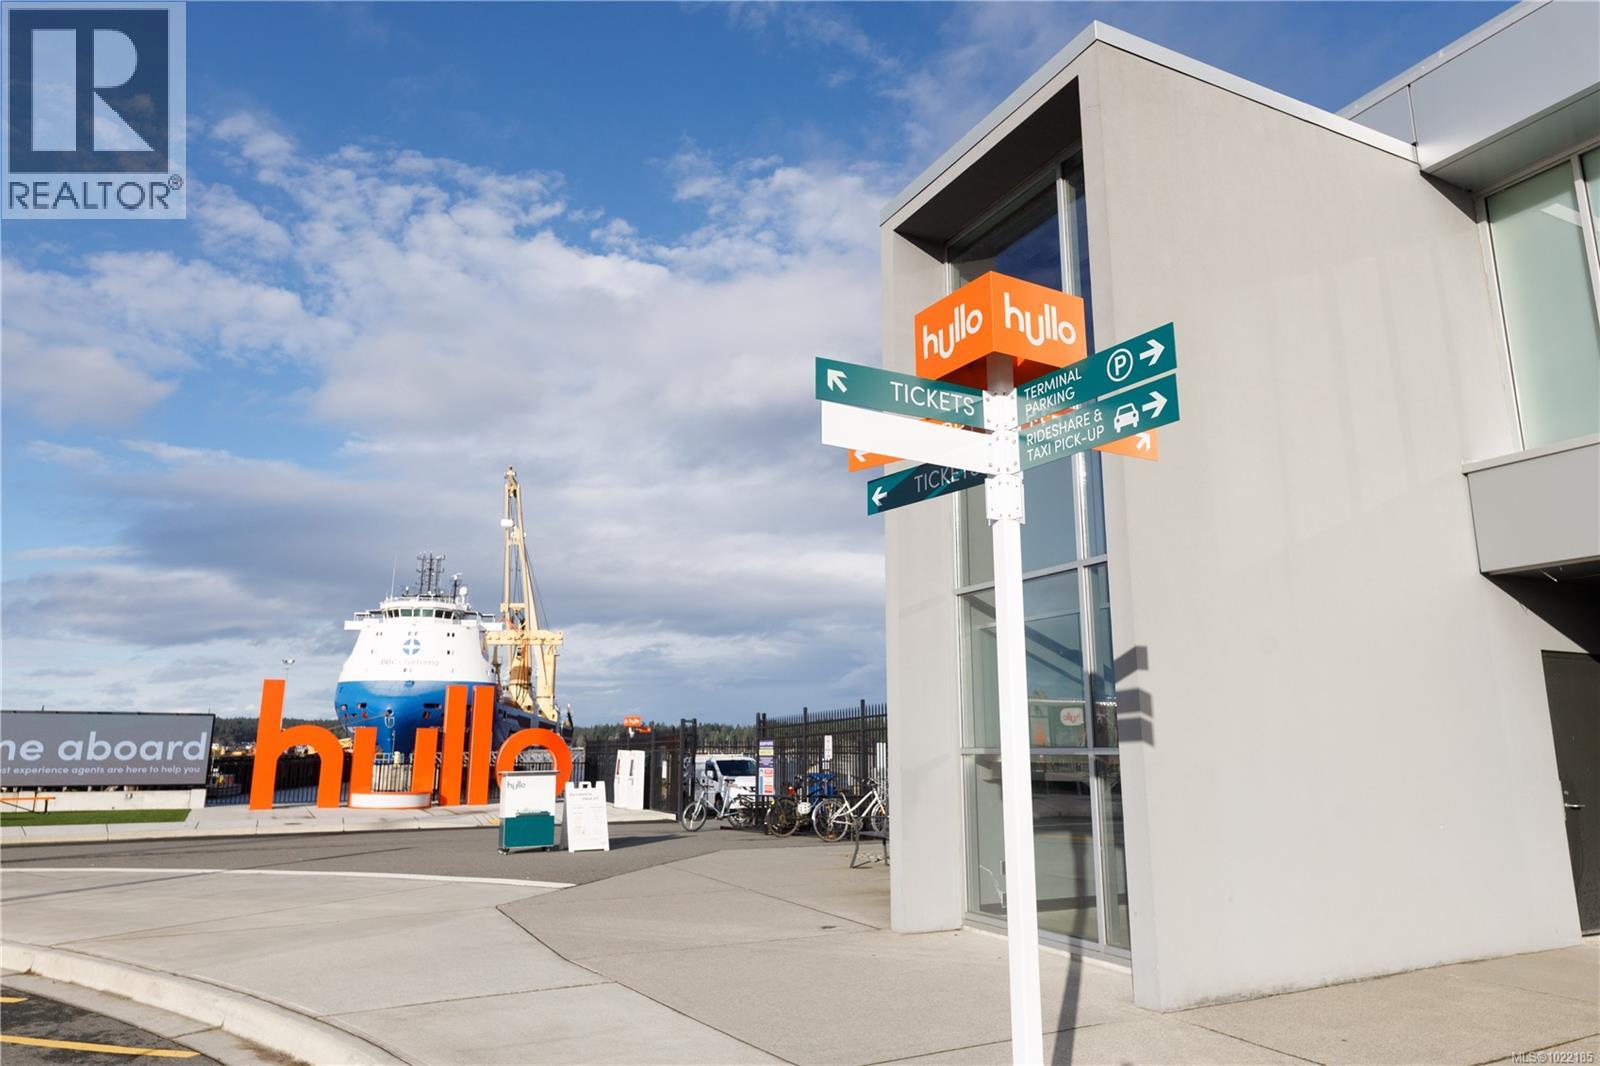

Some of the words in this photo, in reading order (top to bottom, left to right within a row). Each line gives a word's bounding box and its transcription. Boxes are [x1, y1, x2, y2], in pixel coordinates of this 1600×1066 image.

[922, 303, 983, 360] hullo
[1004, 292, 1077, 346] hullo
[1114, 354, 1127, 376] P
[890, 381, 975, 416] TICKETS
[1024, 368, 1082, 400] TERMINAL
[1025, 386, 1075, 416] PARKING
[1026, 412, 1090, 446] RIDESHARE
[1094, 409, 1103, 422] &
[1027, 443, 1052, 461] TAXI
[1055, 425, 1104, 453] PICK-UP
[58, 731, 207, 761] aboard
[250, 679, 573, 809] hullo
[13, 766, 69, 776] experience
[72, 767, 105, 776] agents
[126, 765, 147, 774] here
[150, 766, 159, 774] to
[161, 765, 181, 775] help
[184, 767, 200, 775] you
